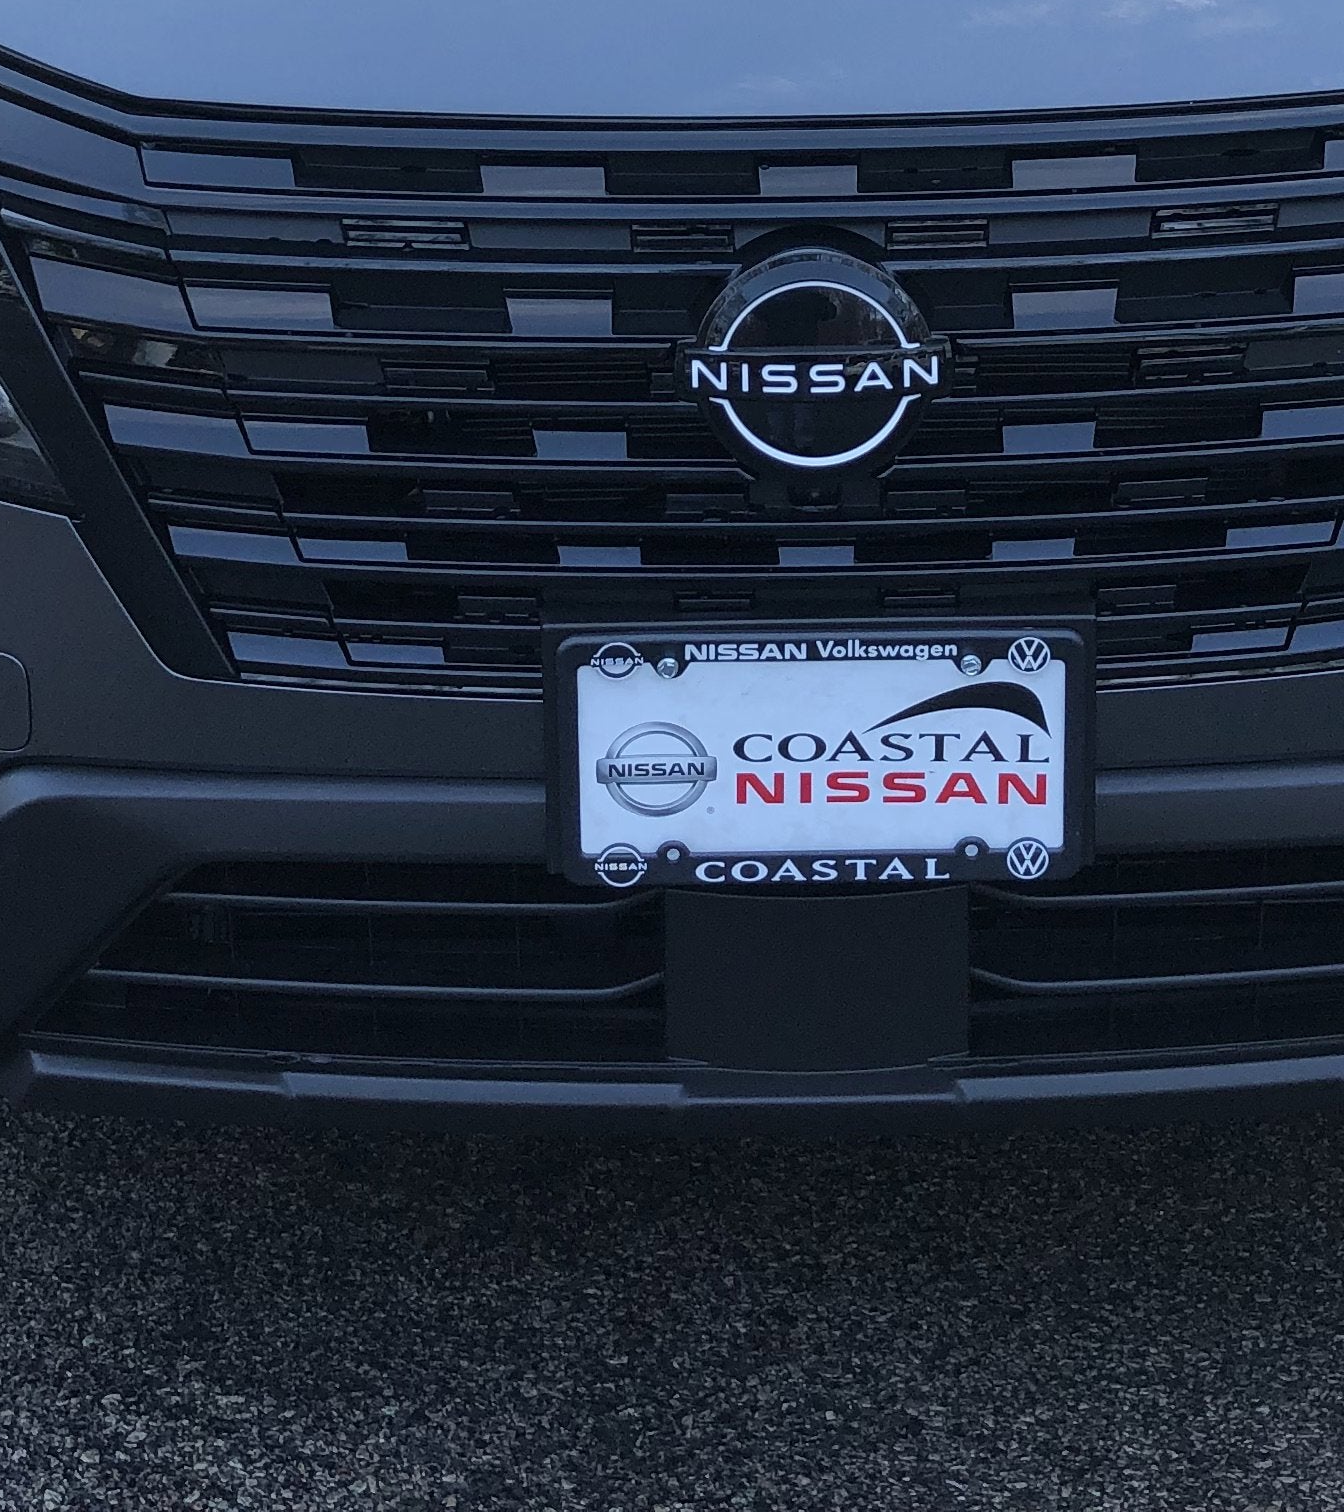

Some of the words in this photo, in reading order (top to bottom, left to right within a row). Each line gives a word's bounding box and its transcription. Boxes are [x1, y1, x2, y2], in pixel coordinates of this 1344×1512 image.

[690, 355, 939, 394] NISSAN
[590, 656, 644, 667] NISSAN
[684, 643, 807, 661] NISSAN
[815, 639, 958, 661] Volkswagen
[732, 730, 1051, 764] COASTAL
[607, 761, 706, 779] NISSAN
[735, 771, 1048, 805] NISSAN
[594, 861, 648, 872] NISSAN
[694, 857, 951, 883] COASTAL
